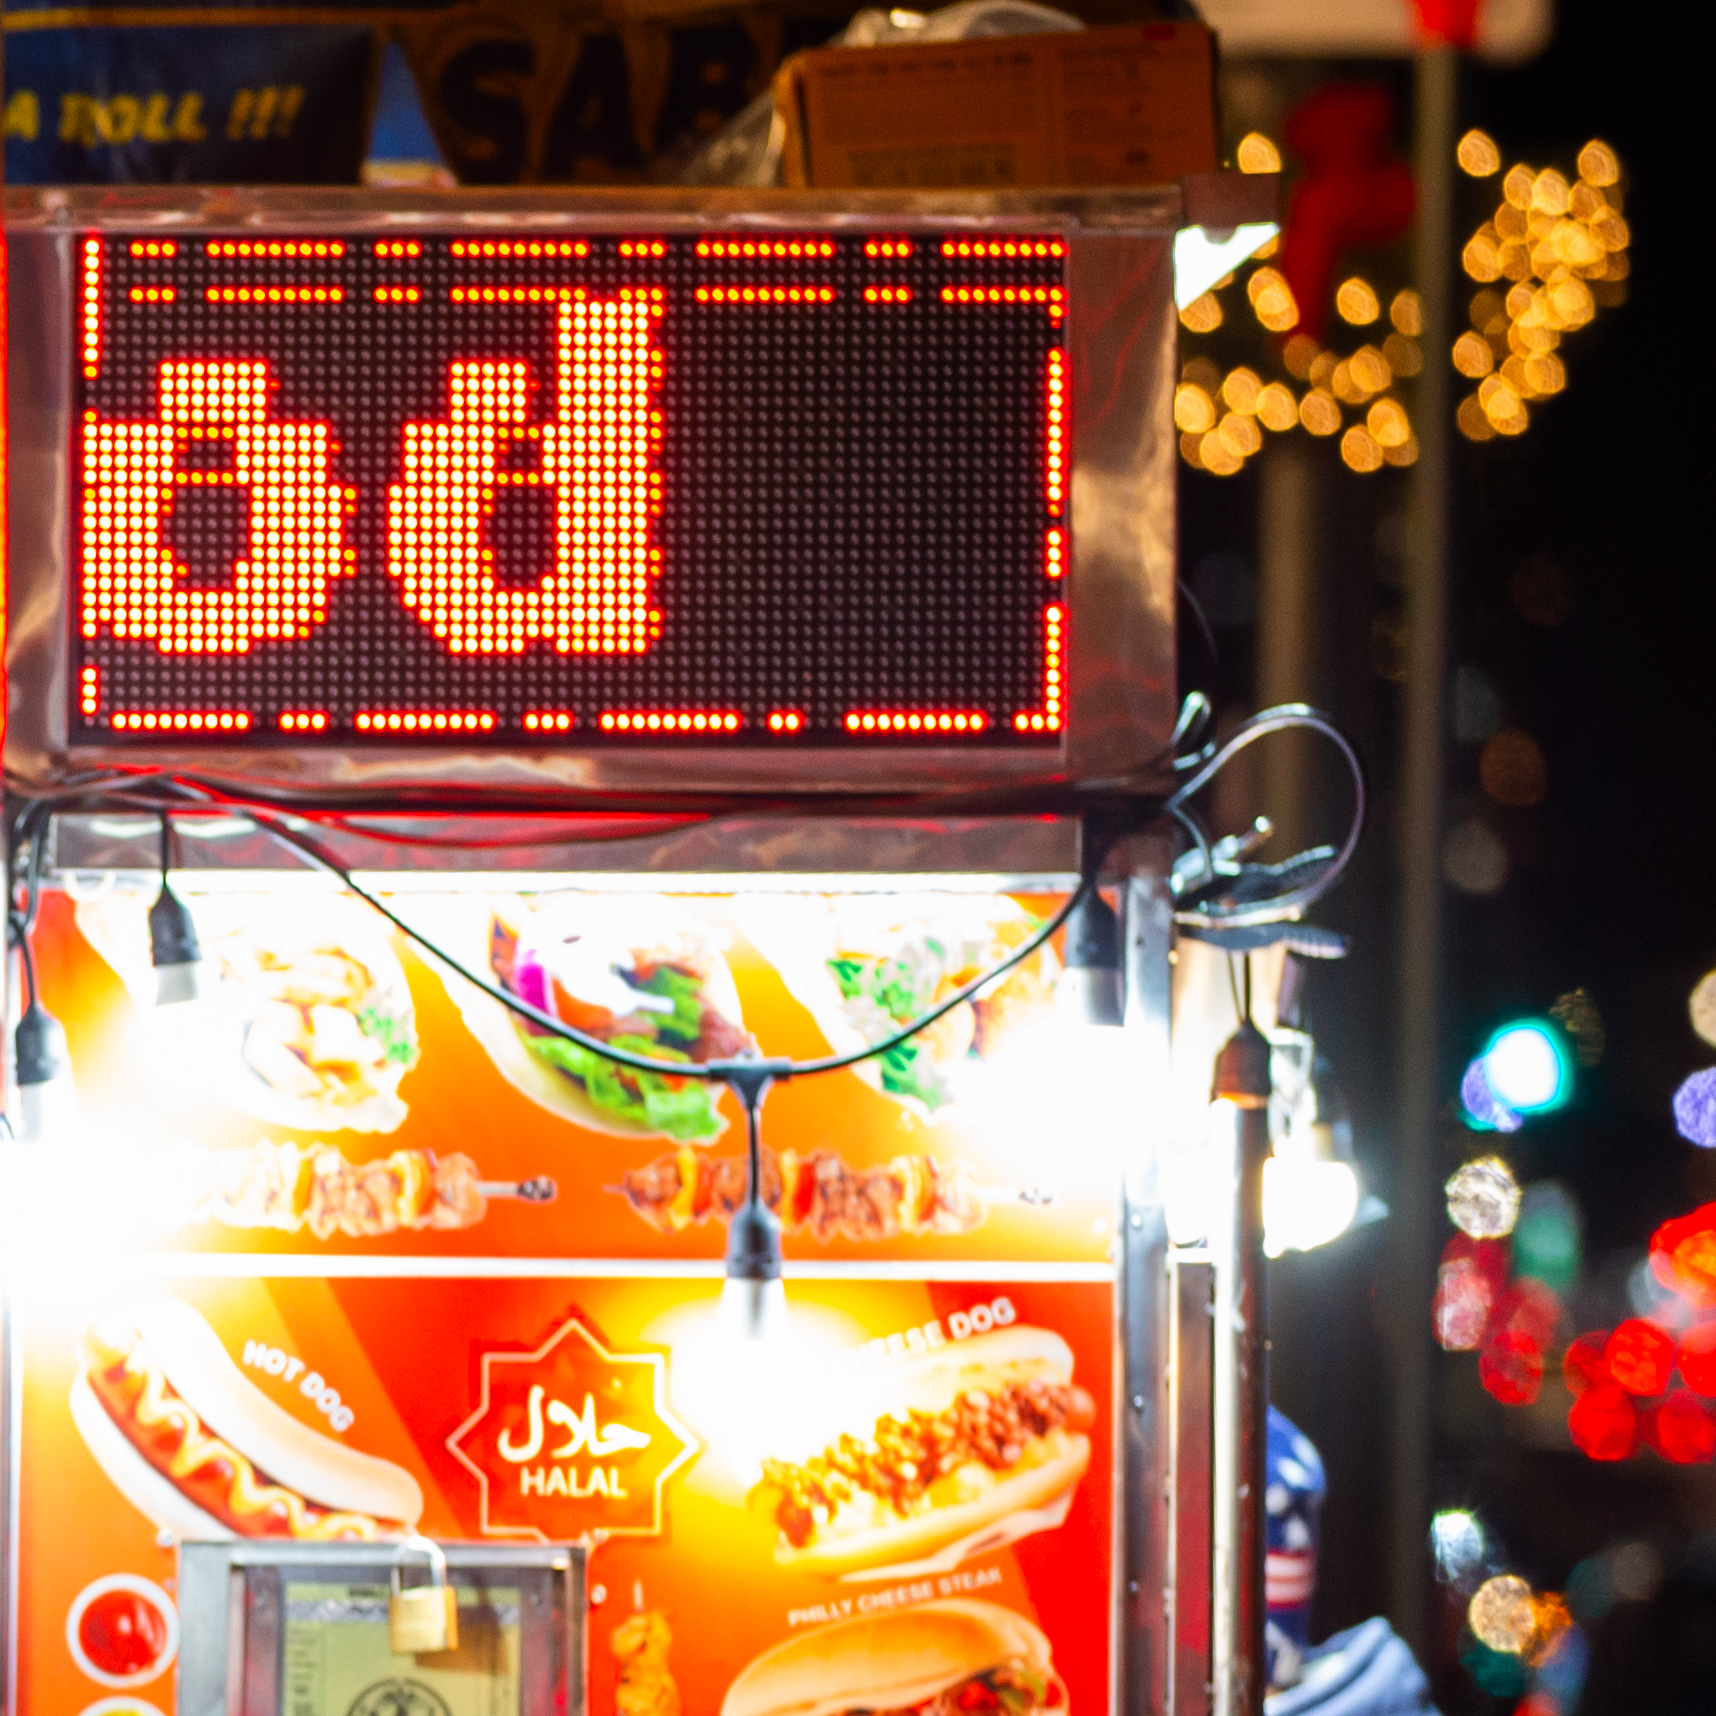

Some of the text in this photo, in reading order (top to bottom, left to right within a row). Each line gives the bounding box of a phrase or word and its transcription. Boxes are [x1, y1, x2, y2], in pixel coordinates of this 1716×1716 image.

[0, 89, 40, 142] A
[948, 1296, 1016, 1342] DOG
[242, 1340, 356, 1433] HOT DOG
[498, 1385, 651, 1463] حلال
[520, 1466, 628, 1499] HALAL
[786, 1566, 1003, 1628] PHILLY CHEESE STEAK
